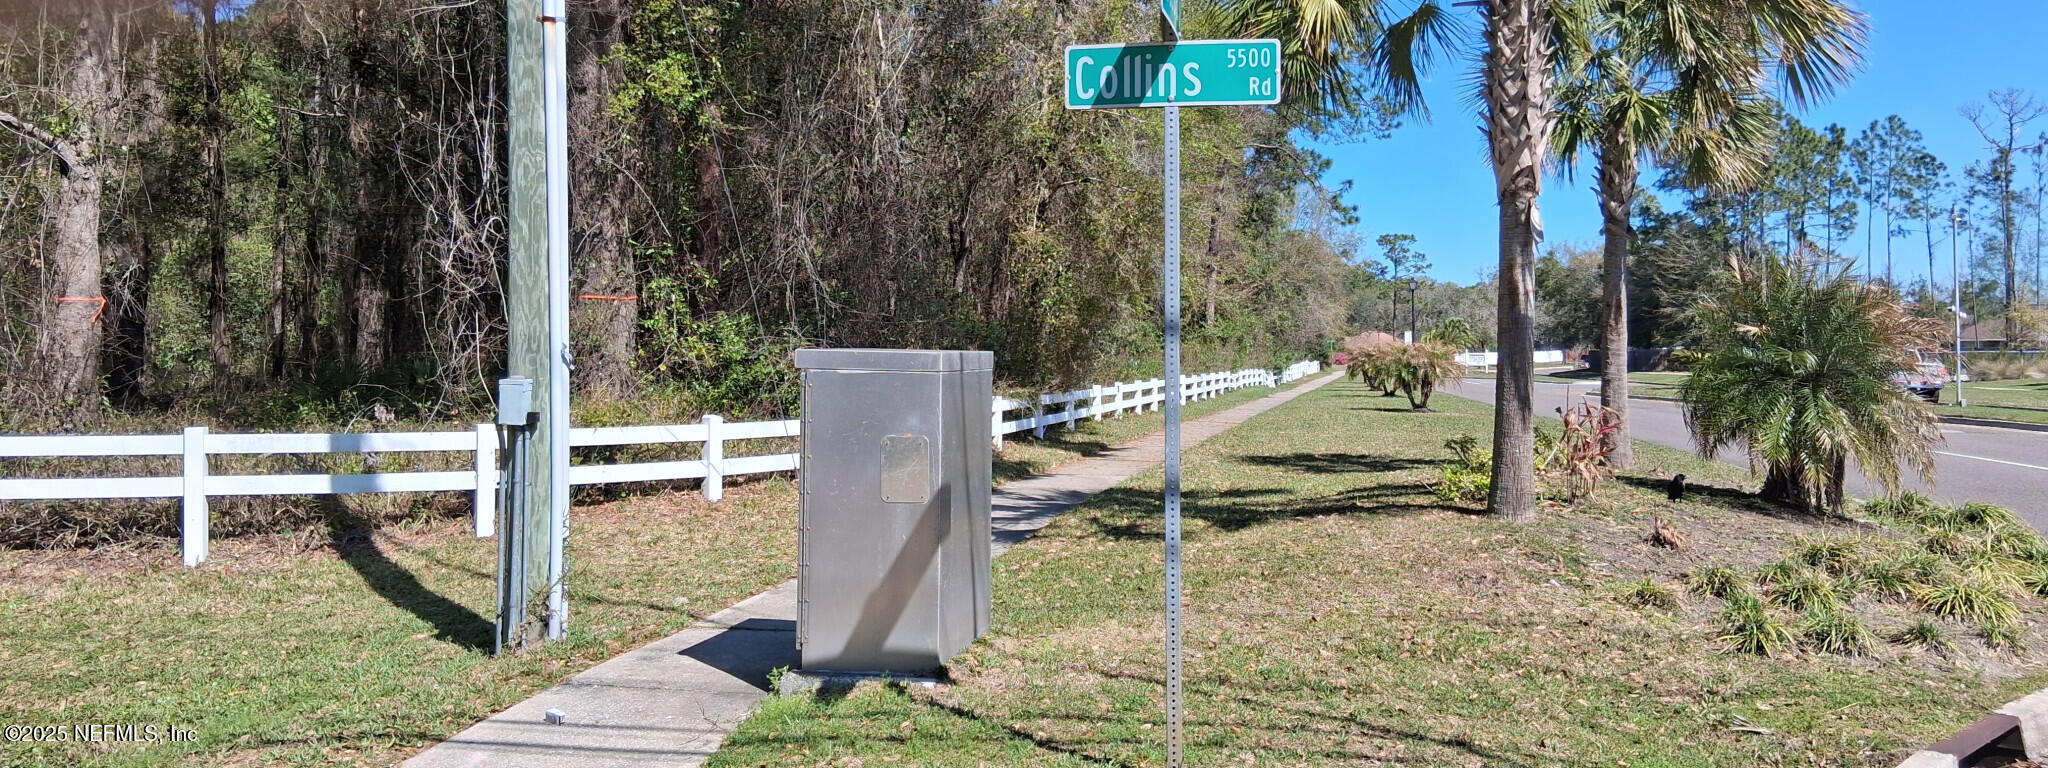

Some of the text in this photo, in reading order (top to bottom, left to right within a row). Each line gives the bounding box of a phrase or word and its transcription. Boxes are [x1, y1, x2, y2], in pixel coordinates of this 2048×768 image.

[1227, 48, 1271, 68] 5500
[1075, 53, 1202, 100] Collins
[1249, 76, 1271, 96] Rd
